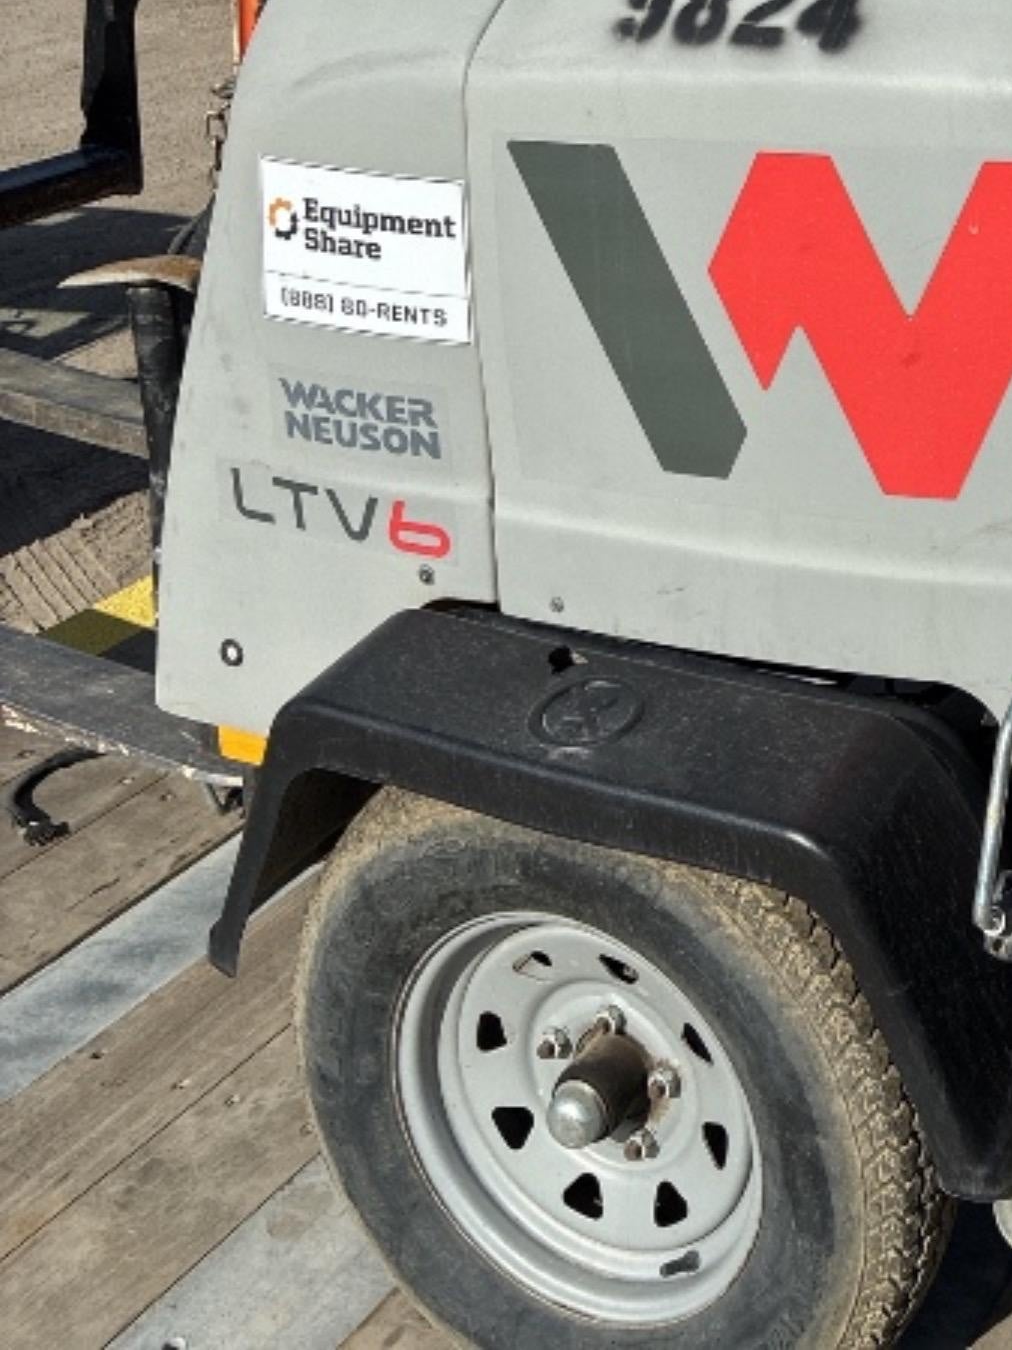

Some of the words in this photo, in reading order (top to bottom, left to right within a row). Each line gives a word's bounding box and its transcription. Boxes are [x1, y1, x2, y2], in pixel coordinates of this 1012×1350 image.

[302, 197, 456, 239] Equipment
[304, 227, 382, 260] Share
[340, 297, 448, 328] 80-RENTS
[277, 377, 438, 429] WACKER
[284, 410, 442, 460] NEUSON
[230, 467, 451, 559] LTV6
